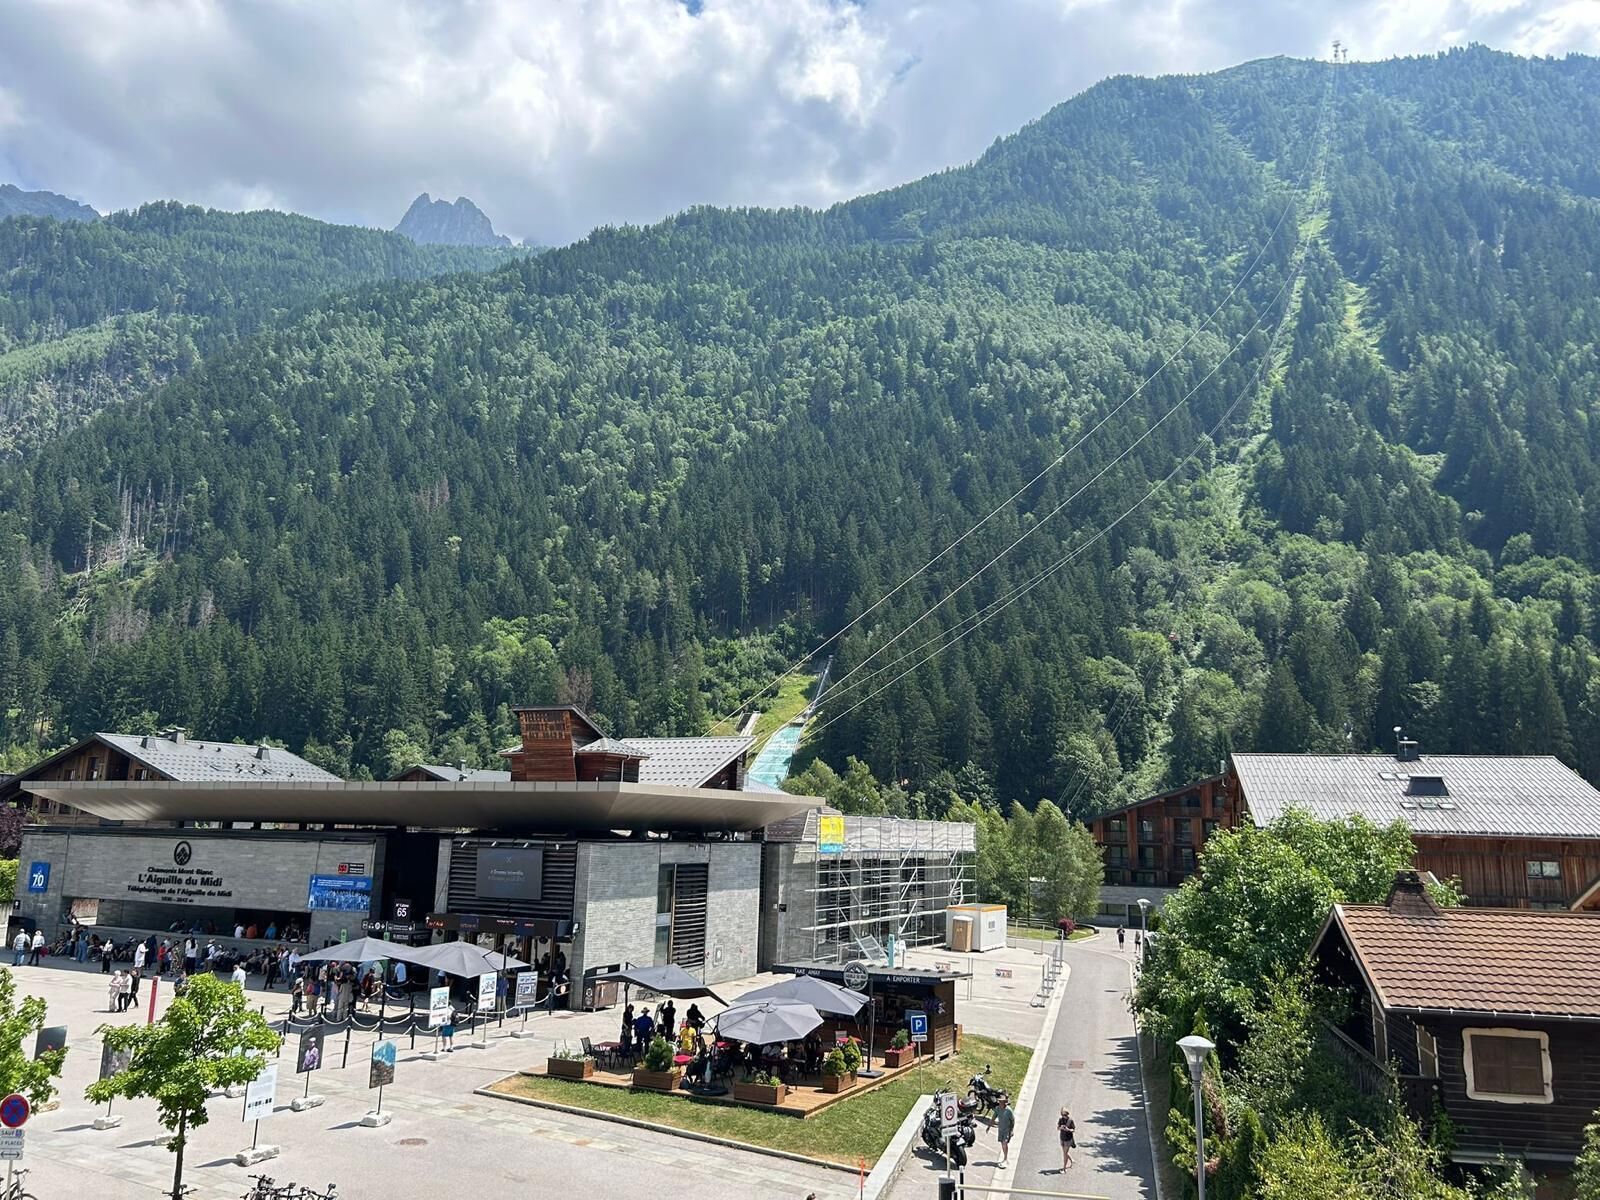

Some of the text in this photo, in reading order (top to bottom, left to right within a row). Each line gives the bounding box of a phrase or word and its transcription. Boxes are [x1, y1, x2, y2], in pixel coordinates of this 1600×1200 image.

[138, 874, 223, 887] L'Aiguille du Midi
[397, 908, 406, 917] 65
[916, 1020, 922, 1030] P
